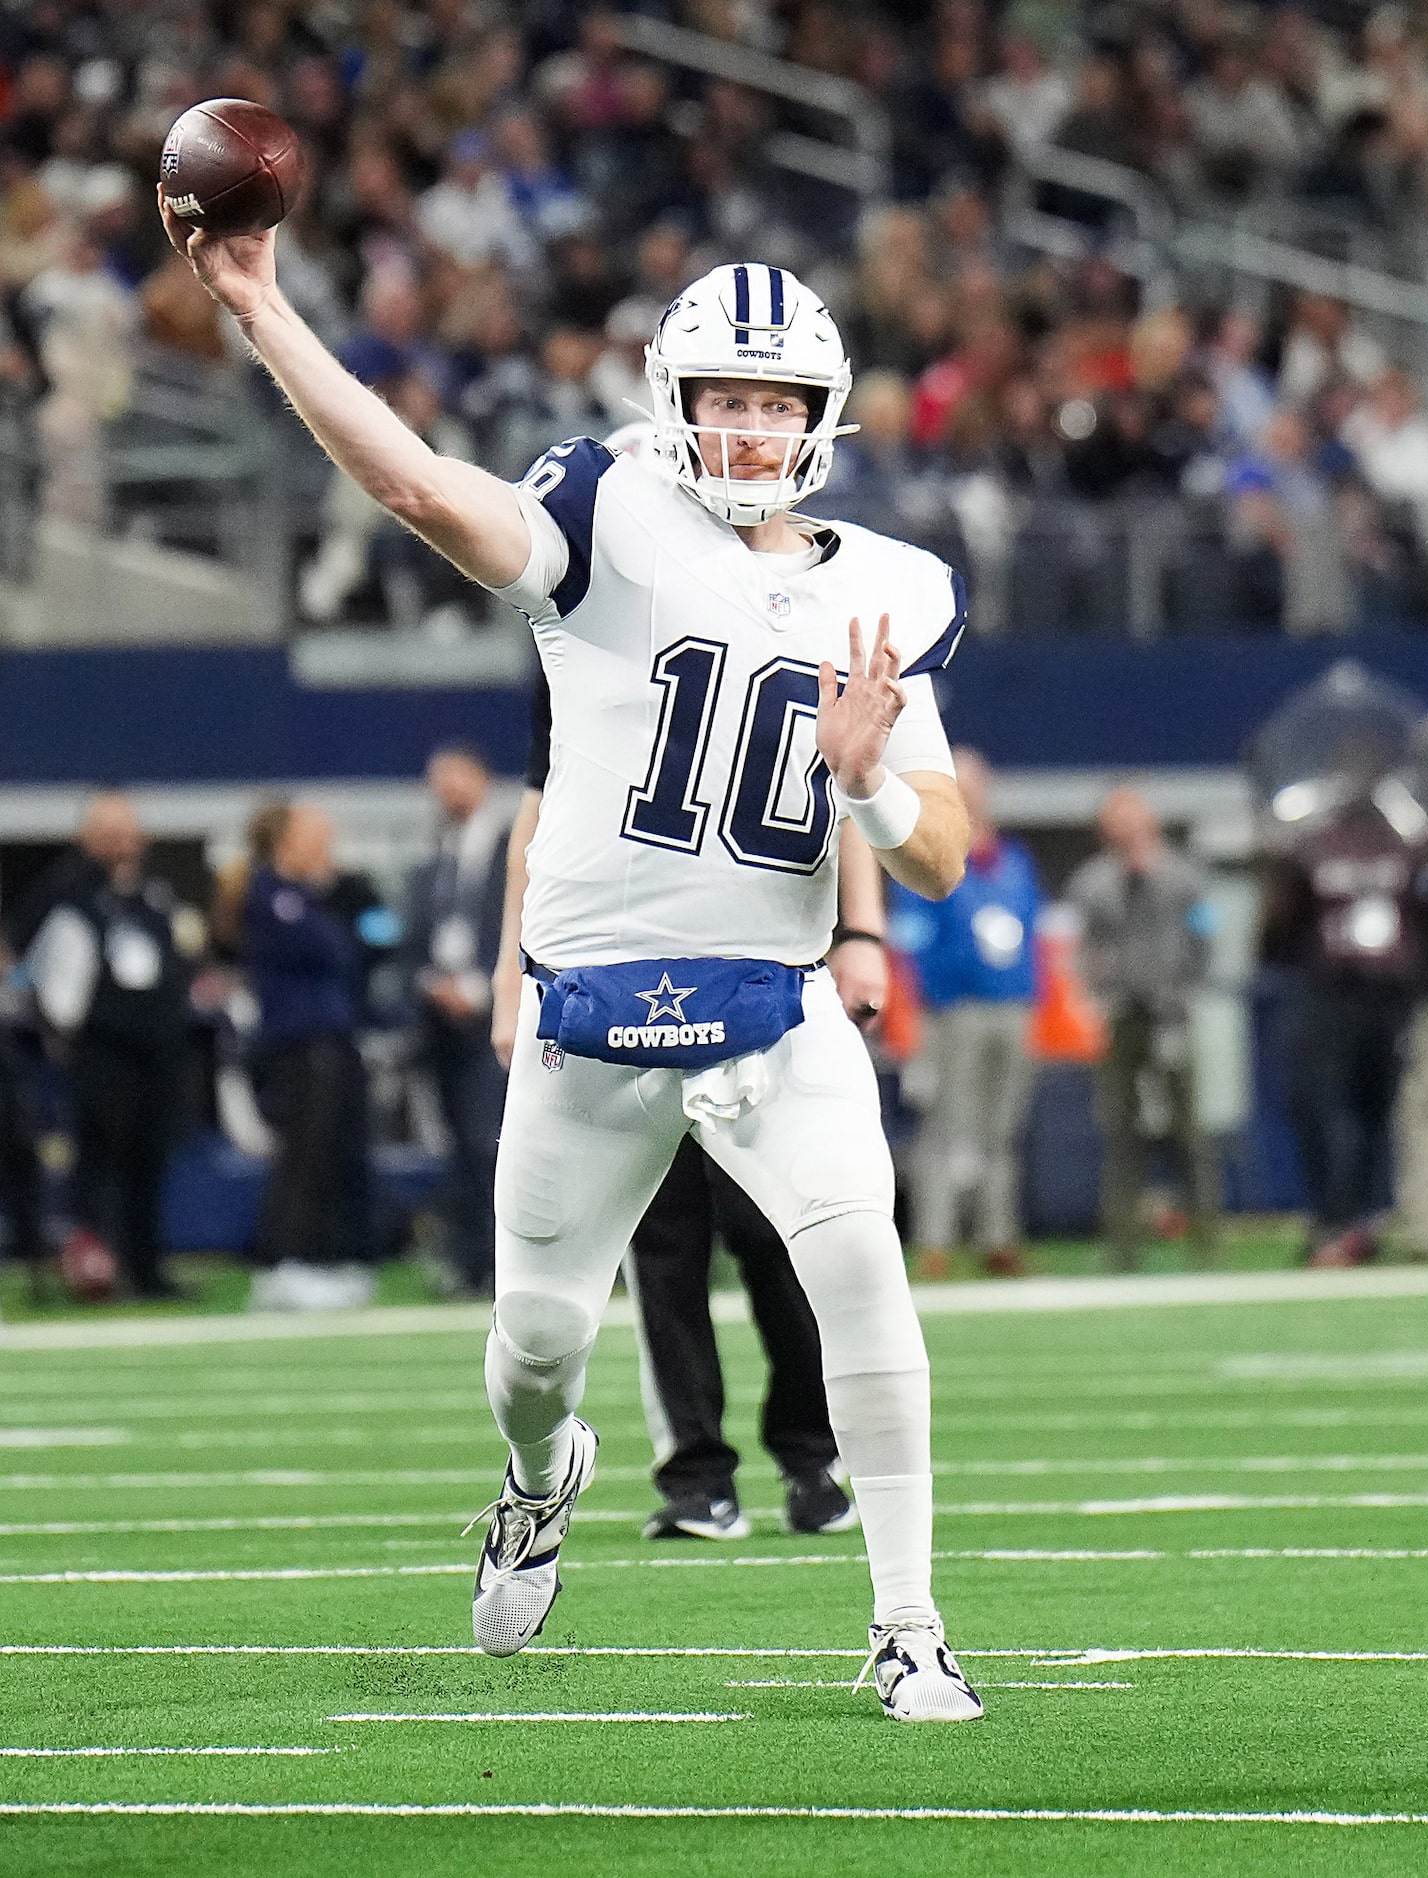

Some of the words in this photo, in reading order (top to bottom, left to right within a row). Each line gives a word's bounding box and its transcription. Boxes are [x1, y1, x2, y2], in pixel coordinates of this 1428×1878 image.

[736, 349, 782, 361] COWBOYS
[619, 635, 850, 877] 10
[607, 1021, 726, 1049] COWBOYS
[544, 1052, 560, 1066] NFL
